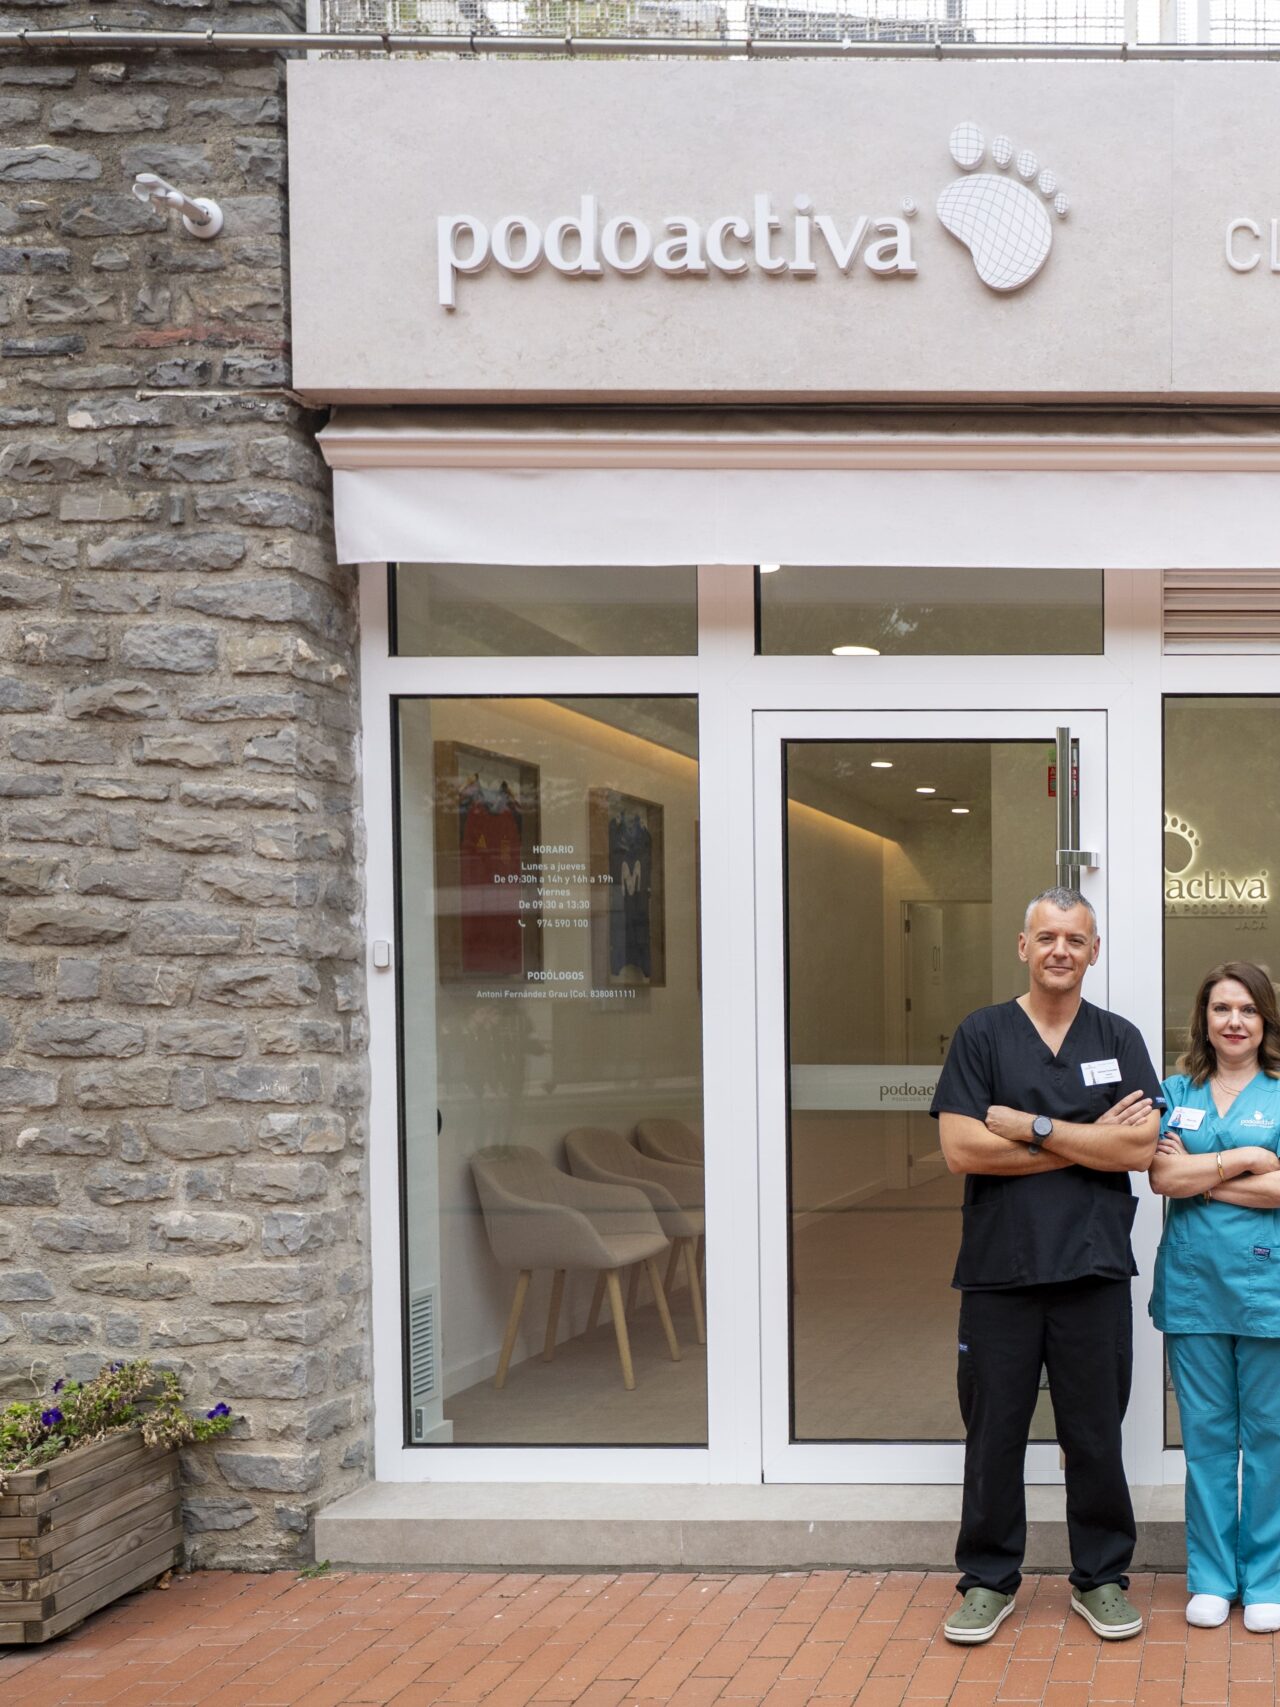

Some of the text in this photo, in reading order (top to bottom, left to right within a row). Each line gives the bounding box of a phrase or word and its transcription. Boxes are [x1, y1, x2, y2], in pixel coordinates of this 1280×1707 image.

[436, 194, 917, 310] podoactiva
[532, 844, 575, 855] HORARIO
[520, 860, 586, 873] Lunes a jueves
[494, 873, 614, 886] De 09:30h a 14h y 16h a 19h
[536, 887, 571, 897] Viernes
[518, 899, 590, 910] De 09:30 a 13:30
[536, 918, 589, 928] 974 590 100
[476, 989, 503, 999] Antoni
[548, 989, 568, 999] Grau
